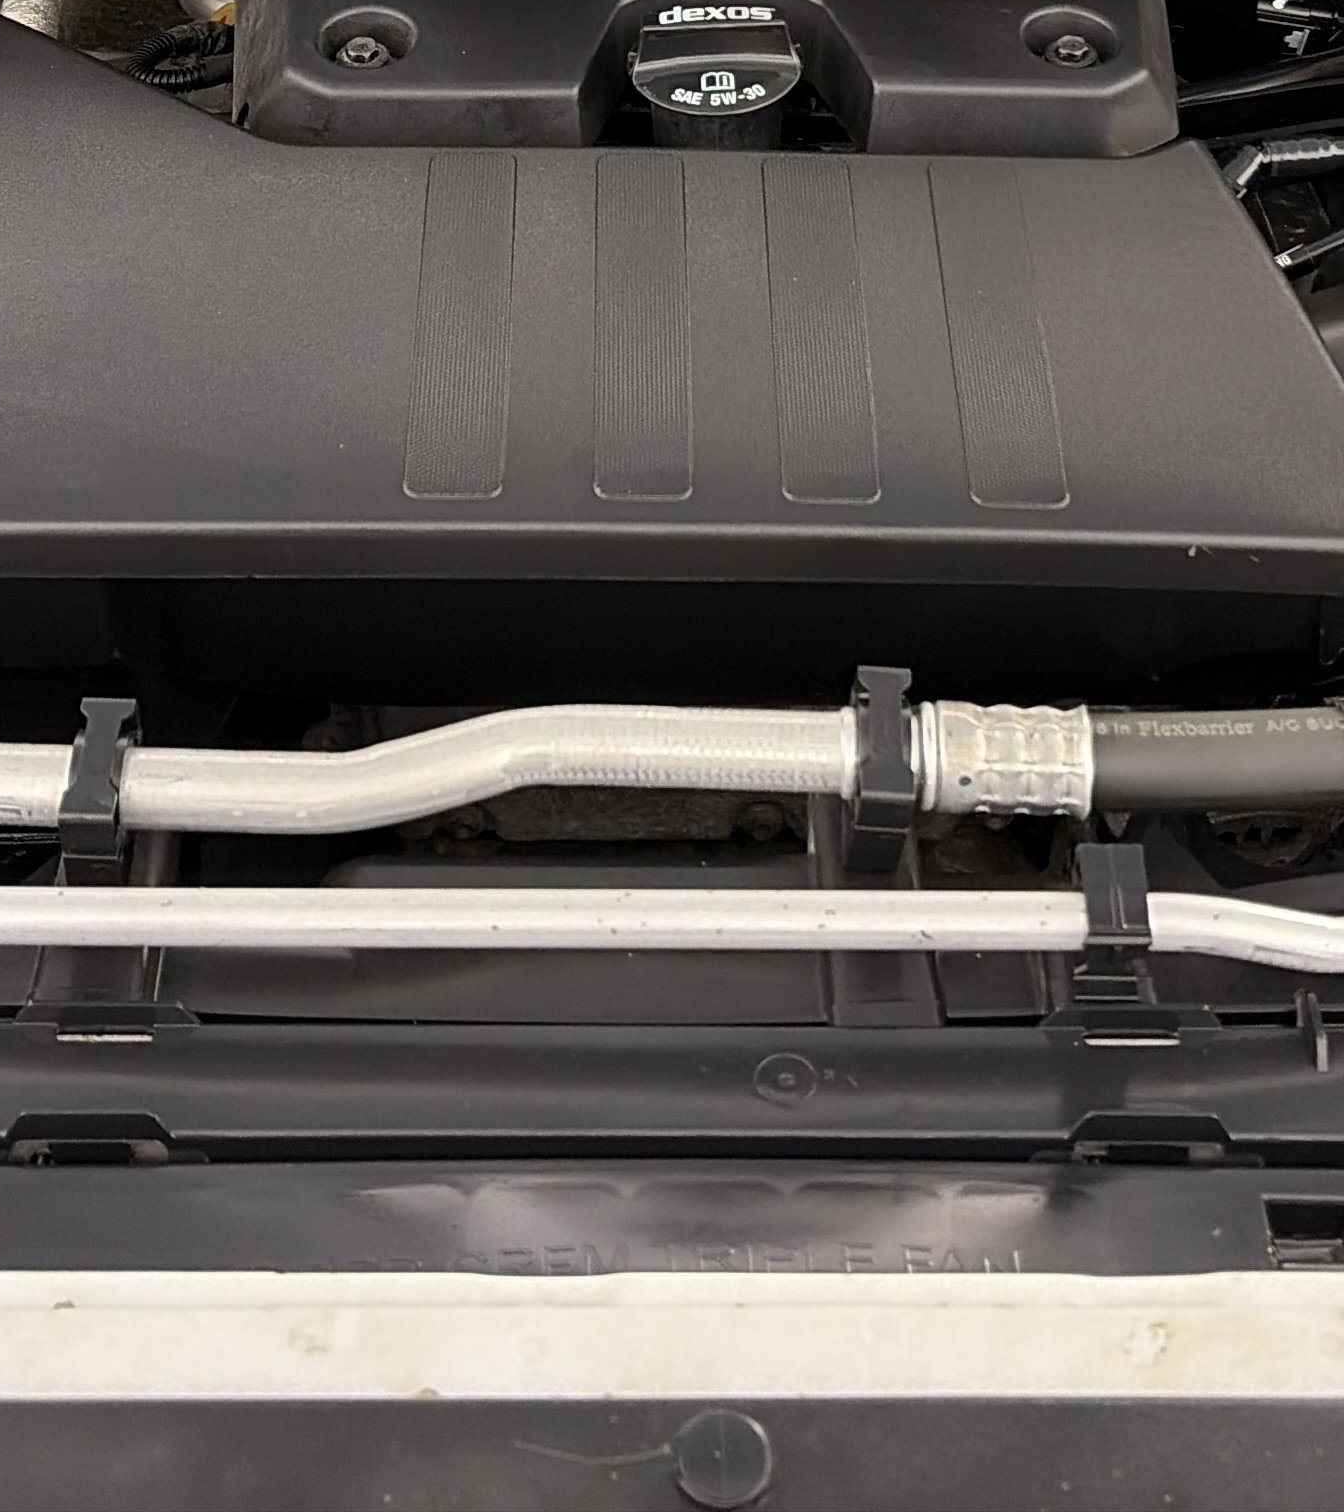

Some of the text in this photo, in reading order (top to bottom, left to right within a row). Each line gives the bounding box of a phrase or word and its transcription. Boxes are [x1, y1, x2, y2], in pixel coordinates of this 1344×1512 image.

[658, 5, 773, 25] dexos
[670, 83, 766, 106] SAE 5W-30
[1138, 719, 1254, 737] Flexbarrier
